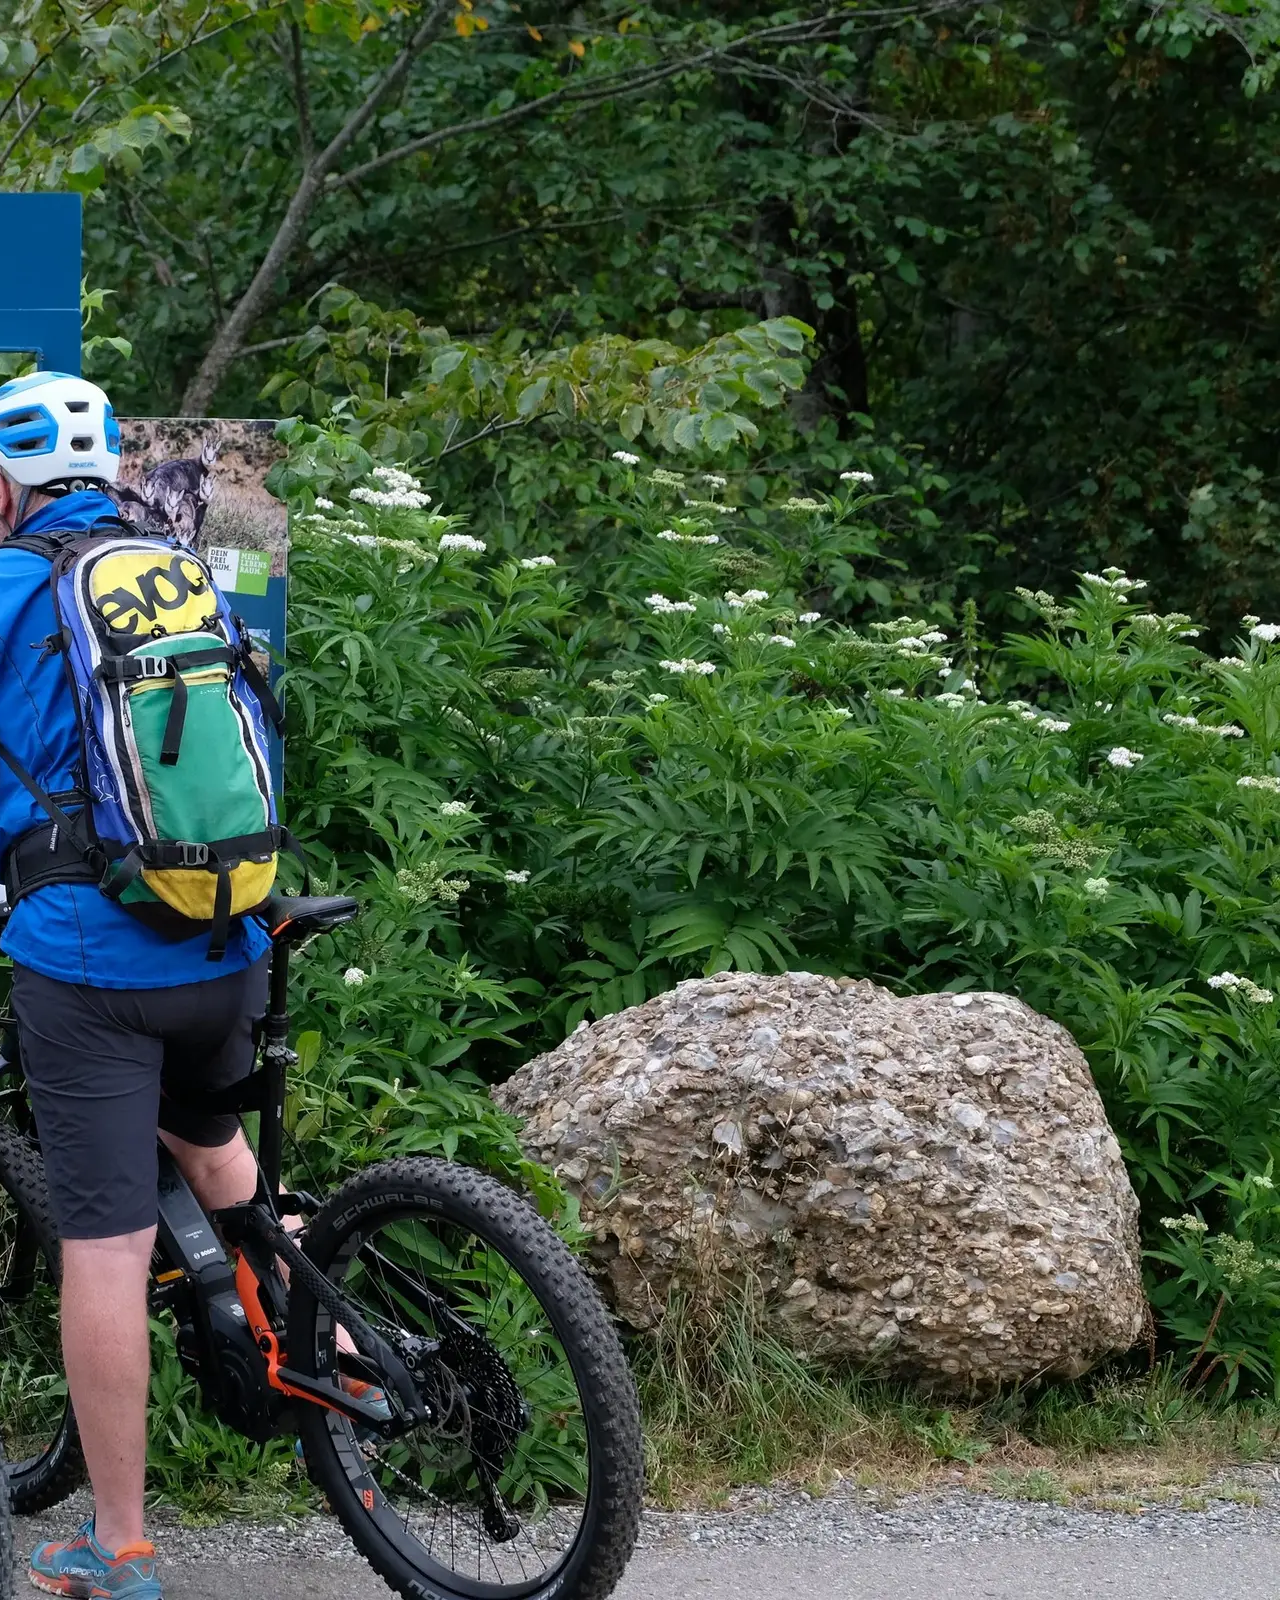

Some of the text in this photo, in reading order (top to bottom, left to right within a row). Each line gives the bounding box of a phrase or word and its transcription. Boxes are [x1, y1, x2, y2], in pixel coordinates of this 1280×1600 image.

[210, 549, 228, 557] DEIN
[240, 552, 260, 561] MEIN
[209, 556, 226, 564] FREI
[95, 555, 210, 635] evoc
[332, 1192, 444, 1232] SCHWALBE
[200, 1246, 217, 1257] BOSCH
[59, 1566, 69, 1574] LA
